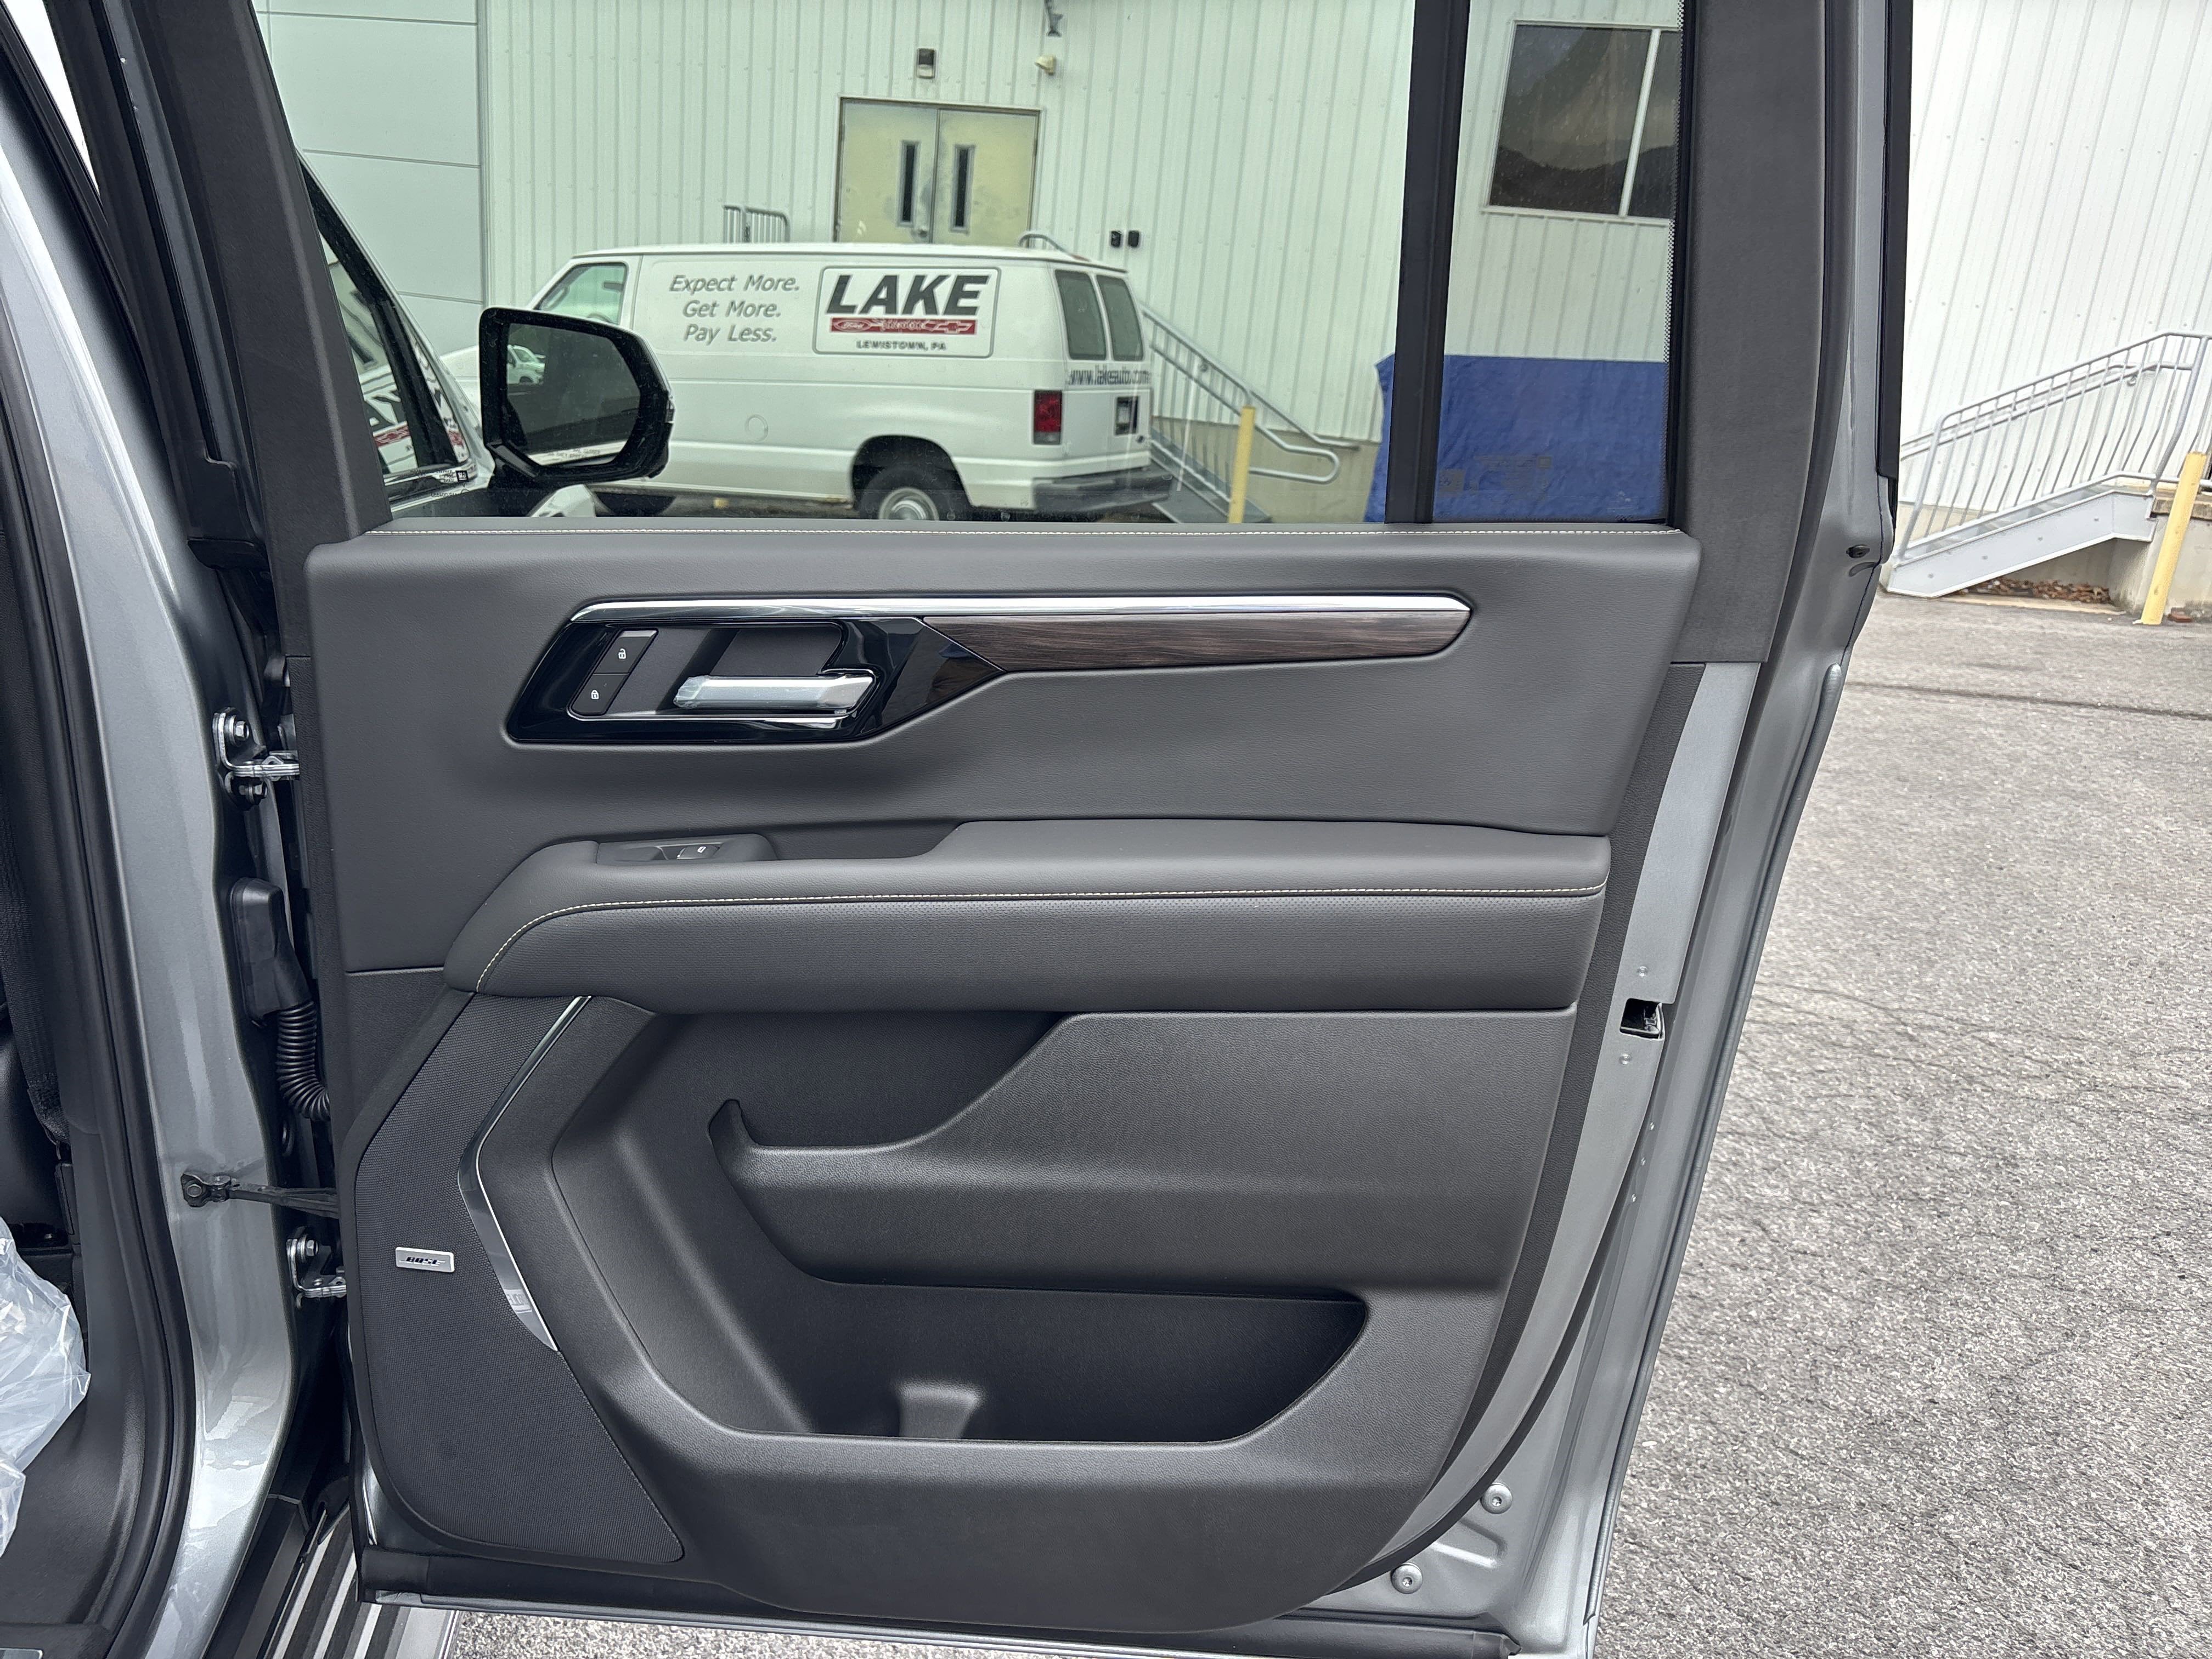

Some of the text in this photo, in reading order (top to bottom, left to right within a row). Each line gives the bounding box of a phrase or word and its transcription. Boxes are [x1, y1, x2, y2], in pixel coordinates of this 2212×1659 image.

[669, 274, 800, 295] Expect More.
[826, 275, 990, 315] LAKE
[682, 300, 781, 317] Get More.
[684, 324, 777, 346] Pay Less.
[856, 340, 946, 351] LEWISTOWN, PA
[402, 1256, 445, 1266] BOSE
